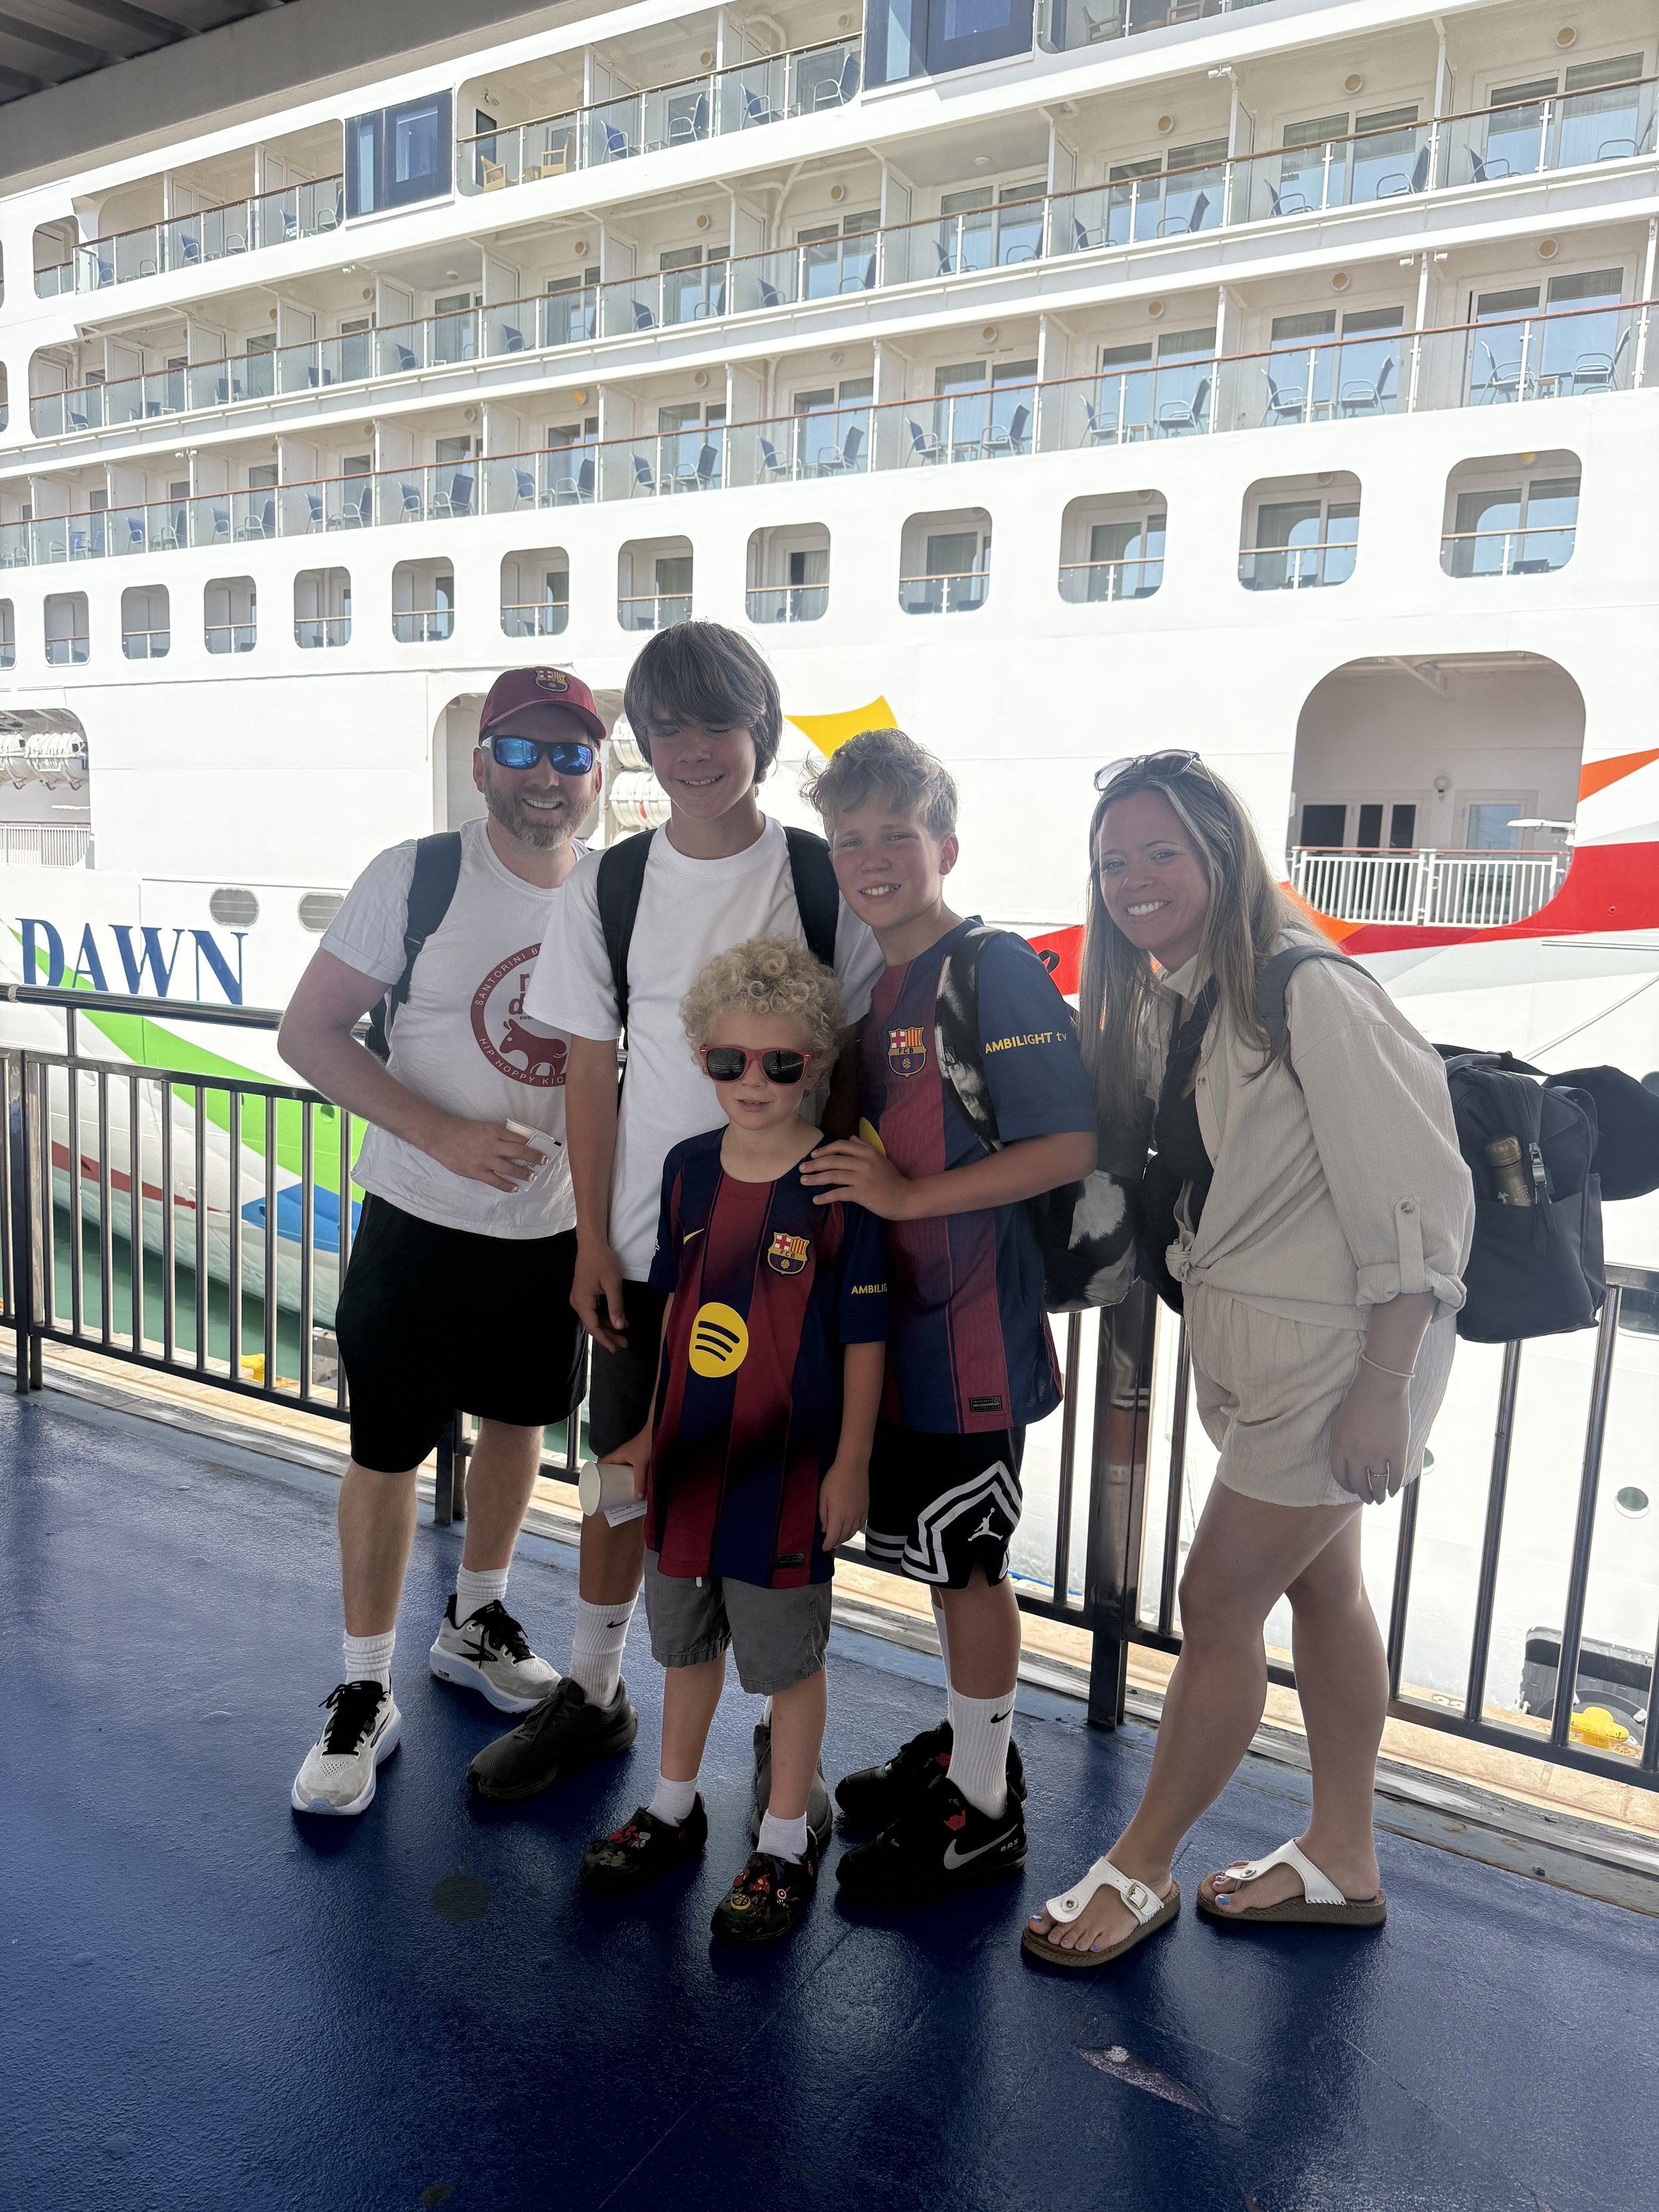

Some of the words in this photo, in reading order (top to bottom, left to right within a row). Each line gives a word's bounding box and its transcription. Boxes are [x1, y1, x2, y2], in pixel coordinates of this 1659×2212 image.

[15, 918, 249, 1005] DAWN
[475, 952, 526, 1005] SANTORINI
[479, 1038, 494, 1055] HIP
[495, 1060, 536, 1084] HOPPY
[985, 1032, 1052, 1054] AMBILIGHT
[1056, 1031, 1066, 1041] tv
[851, 1283, 888, 1294] AMBILIG
